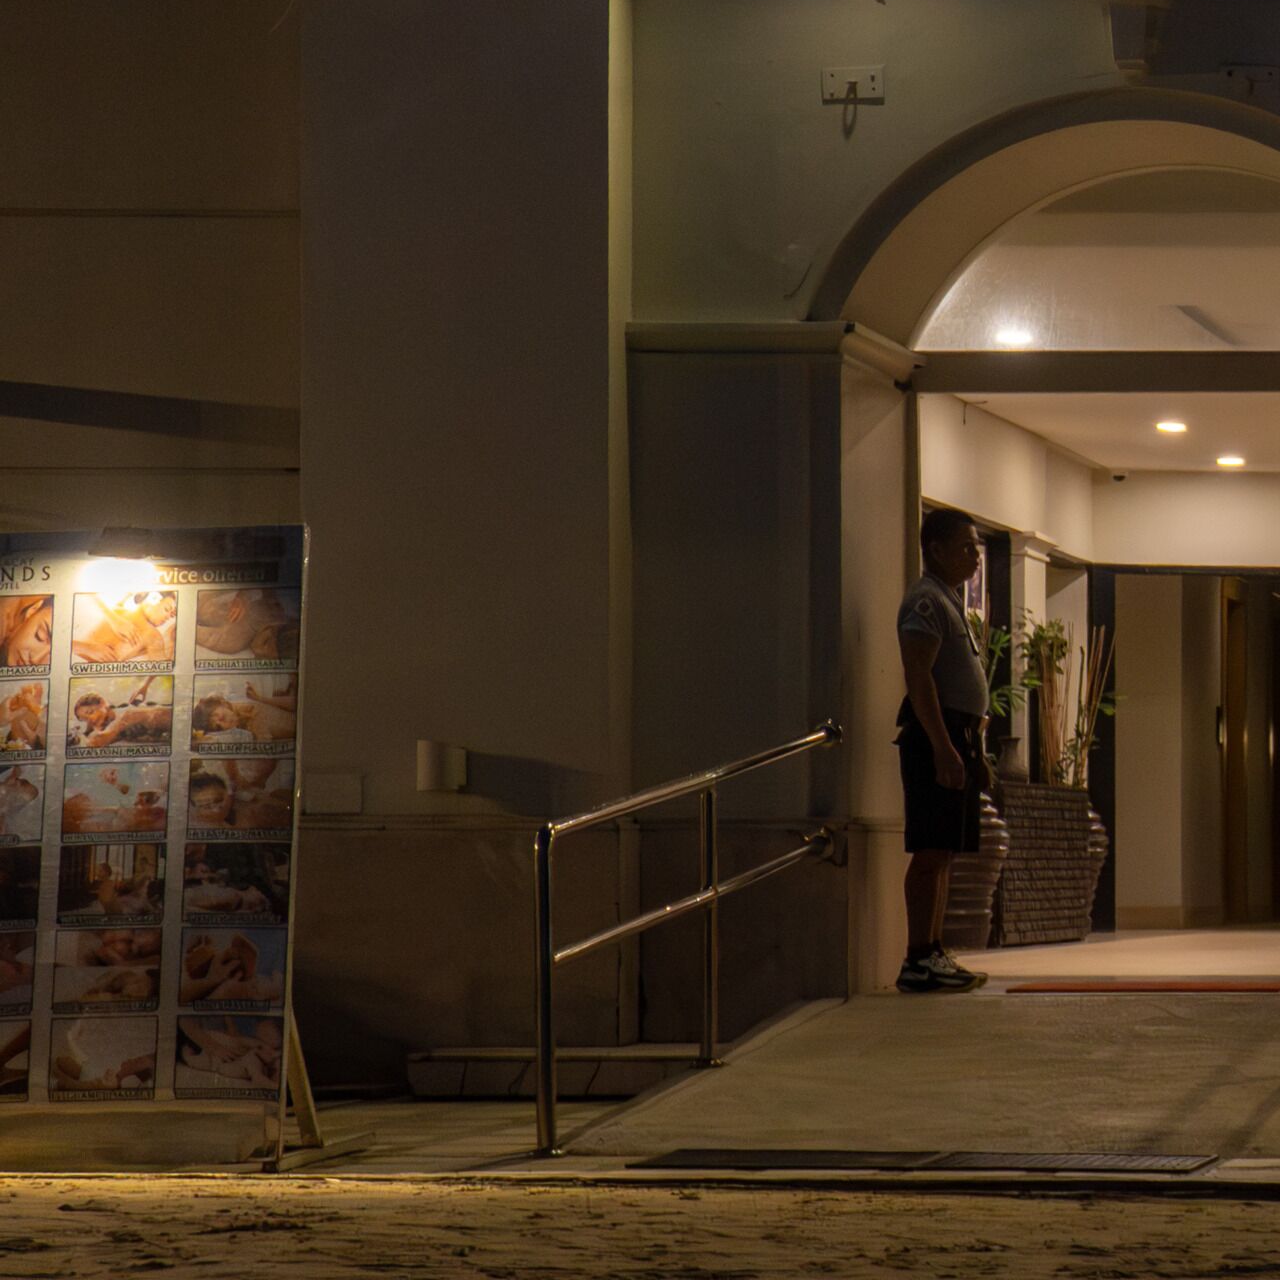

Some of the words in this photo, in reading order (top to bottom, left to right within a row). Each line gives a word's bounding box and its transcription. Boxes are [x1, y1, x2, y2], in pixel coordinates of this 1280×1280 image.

[7, 665, 48, 676] MASSAGE
[73, 662, 119, 673] SWEDISH
[121, 661, 172, 672] MASSAGE
